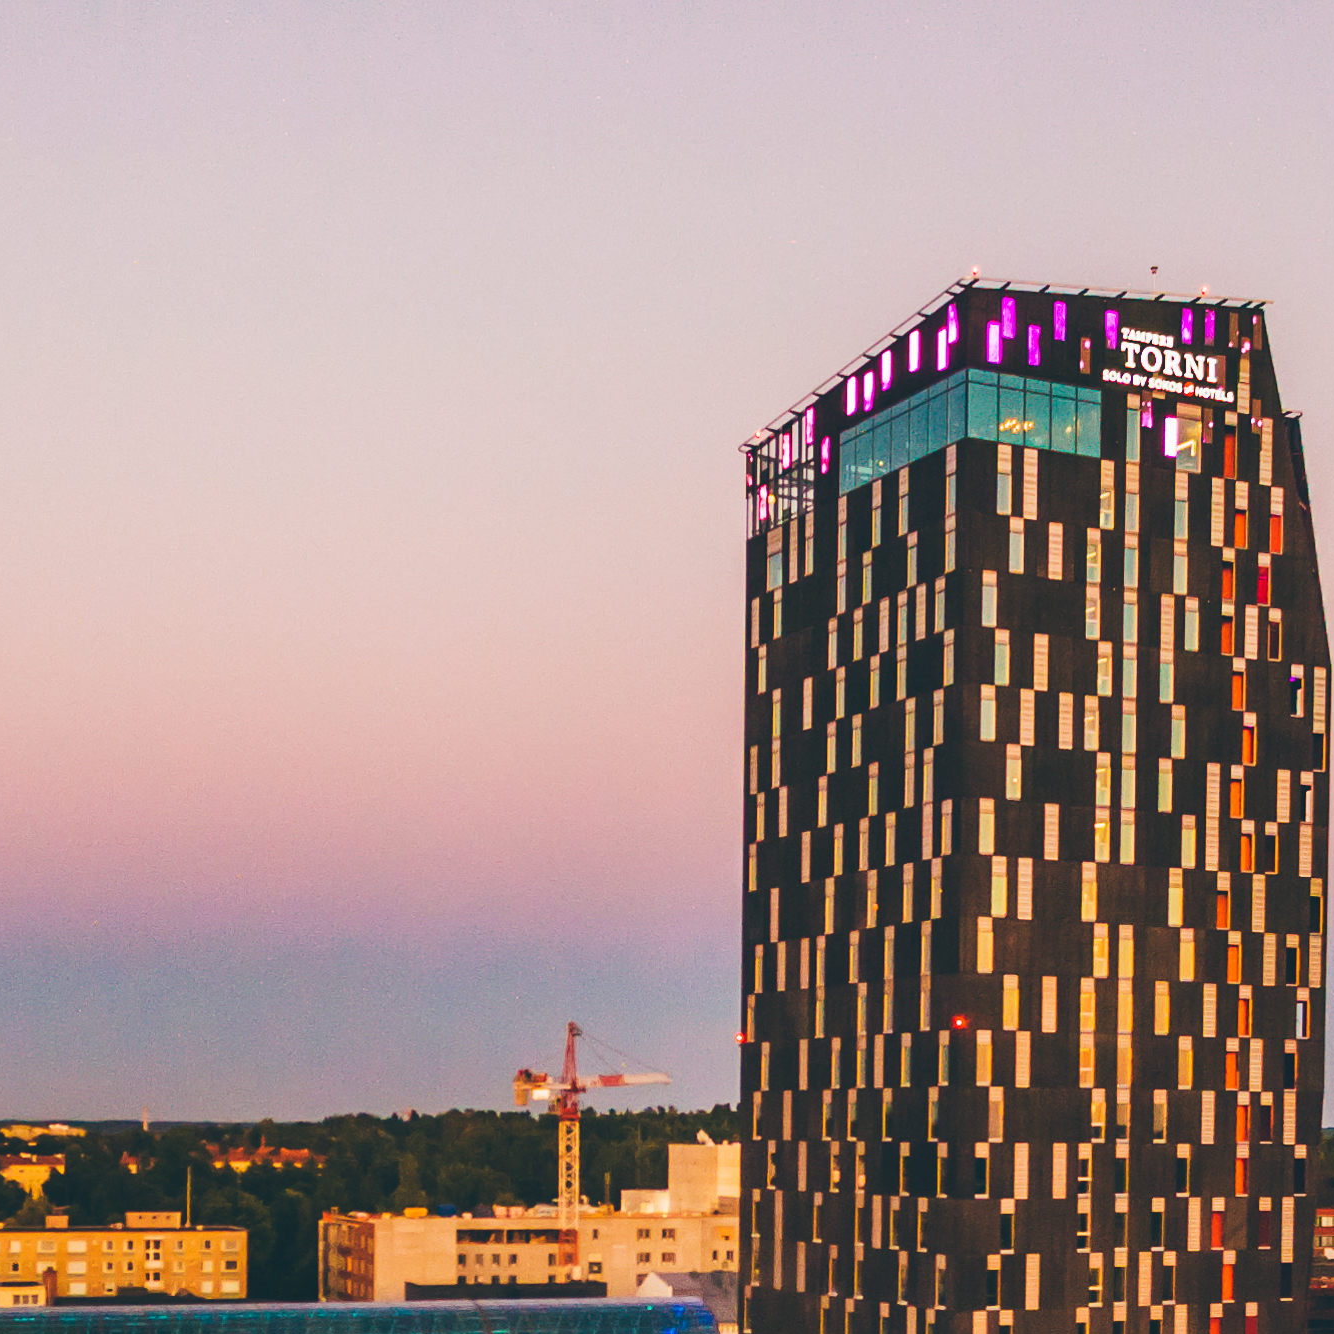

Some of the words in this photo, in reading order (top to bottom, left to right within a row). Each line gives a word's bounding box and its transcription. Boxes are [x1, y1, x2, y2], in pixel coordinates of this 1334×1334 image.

[1121, 327, 1174, 348] TAMPERE
[1120, 341, 1217, 383] TORNI
[1102, 369, 1131, 385] SOLO
[1132, 374, 1147, 387] BY
[1148, 377, 1183, 393] SOKOS
[1194, 386, 1235, 403] HOTELS
